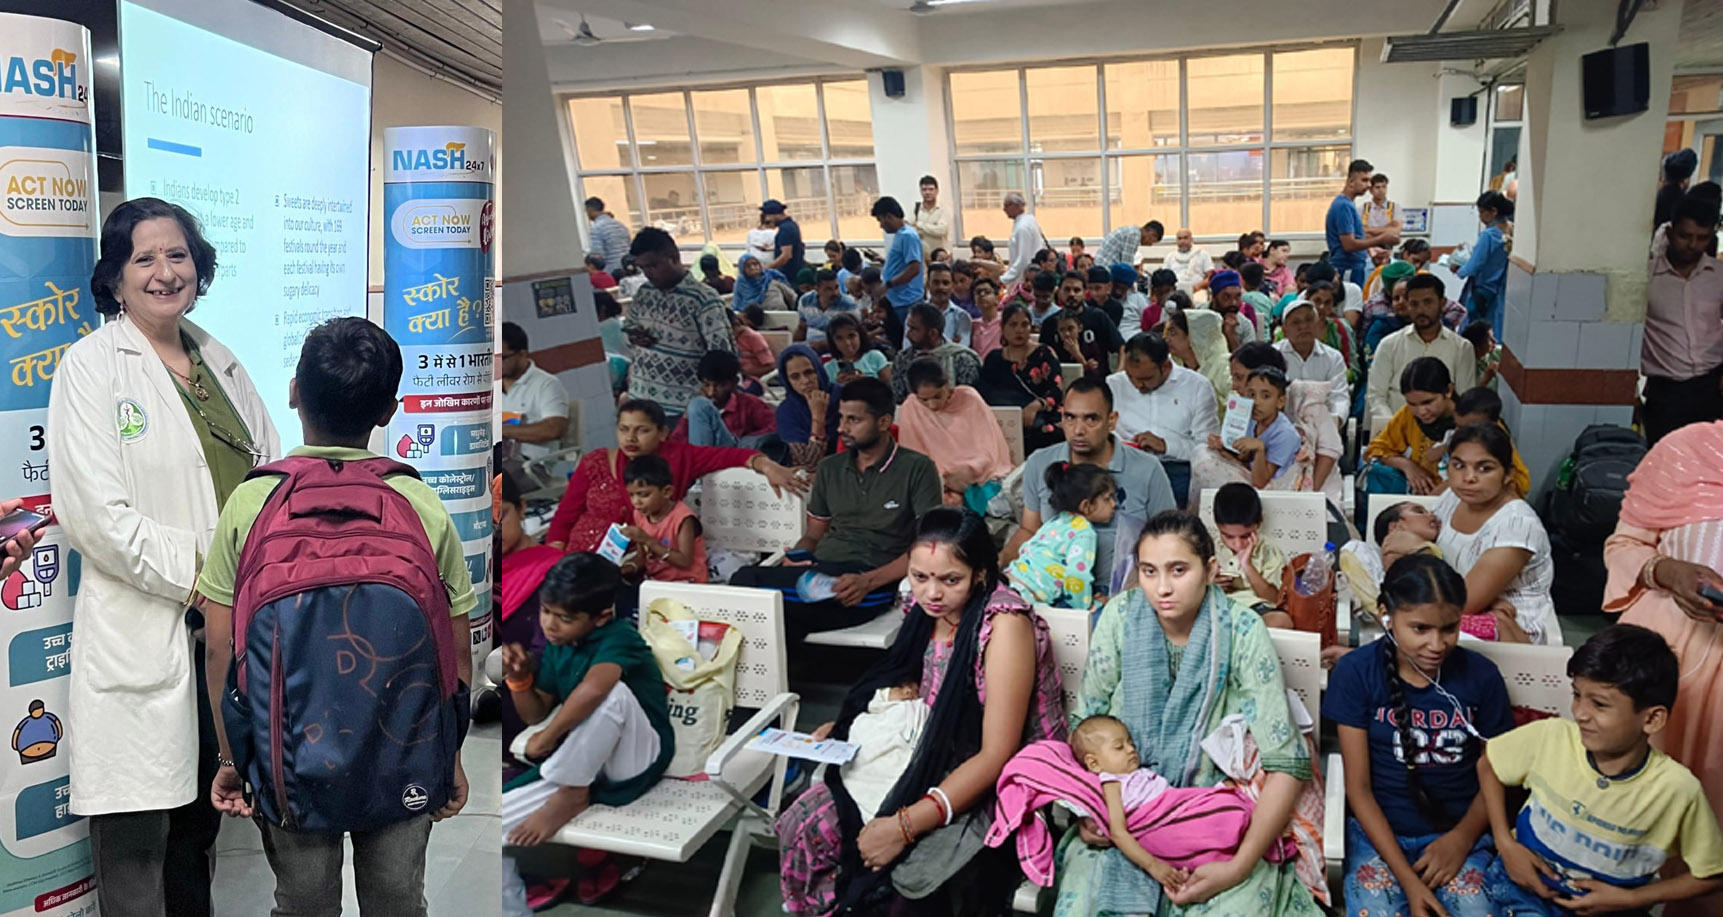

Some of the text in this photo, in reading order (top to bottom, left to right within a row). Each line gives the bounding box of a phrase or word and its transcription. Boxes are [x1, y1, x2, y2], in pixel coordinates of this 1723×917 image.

[0, 57, 77, 100] ASH
[144, 79, 253, 134] The Indian scenario
[393, 149, 485, 171] NASH 24x7
[7, 175, 87, 197] ACT NOW
[163, 178, 240, 207] Indians develop type 2
[7, 197, 88, 212] SCREEN TODAY
[283, 192, 302, 209] Sweets
[311, 196, 327, 215] deeply
[210, 210, 229, 228] lower
[230, 216, 242, 233] age
[242, 213, 254, 230] and
[411, 225, 471, 235] SCREEN TODAY
[412, 214, 471, 226] ACT NOW
[239, 239, 247, 254] to
[283, 259, 295, 275] each
[296, 259, 314, 275] festival
[301, 281, 320, 299] delicacy
[402, 273, 460, 306] स्कोर
[0, 281, 80, 338] स्कोर
[408, 309, 451, 334] क्या
[418, 354, 429, 370] 3
[433, 354, 444, 369] में
[446, 353, 457, 369] से
[459, 354, 465, 368] 1
[436, 373, 461, 388] लीवर
[463, 372, 476, 386] रोग
[420, 399, 432, 410] इन
[434, 396, 461, 409] जोखिम
[29, 425, 46, 451] 3
[42, 633, 66, 650] उच्च
[668, 697, 700, 726] ing
